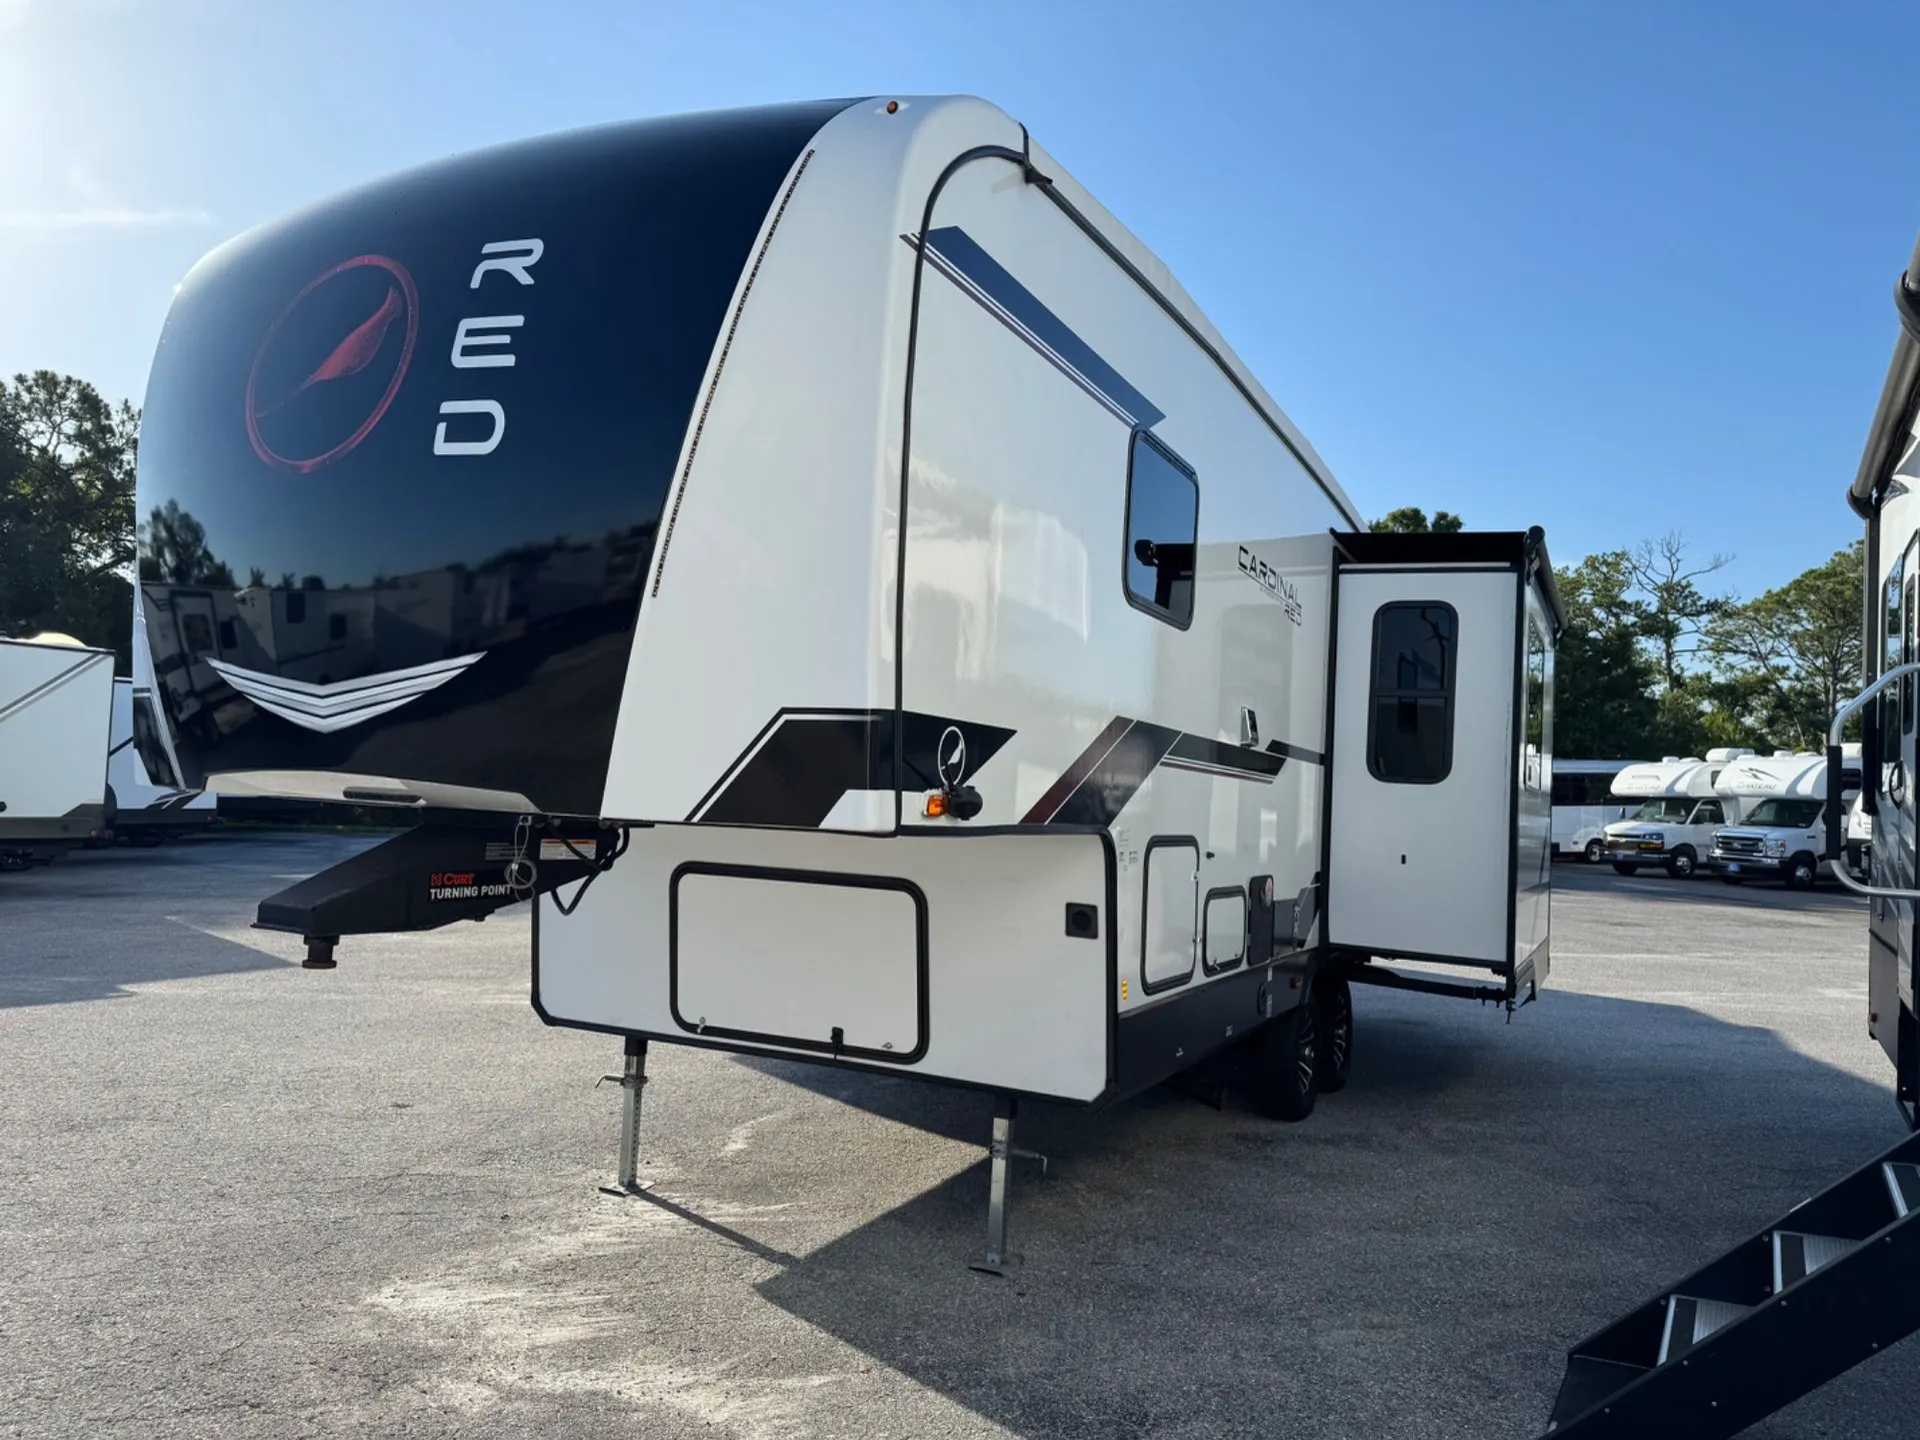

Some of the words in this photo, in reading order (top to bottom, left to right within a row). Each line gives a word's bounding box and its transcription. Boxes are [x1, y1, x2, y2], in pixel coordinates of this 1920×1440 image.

[433, 237, 545, 456] RED
[1238, 544, 1303, 609] CARDINAL
[430, 886, 479, 900] TURNING
[481, 883, 511, 897] POINT
[443, 872, 475, 886] CURT
